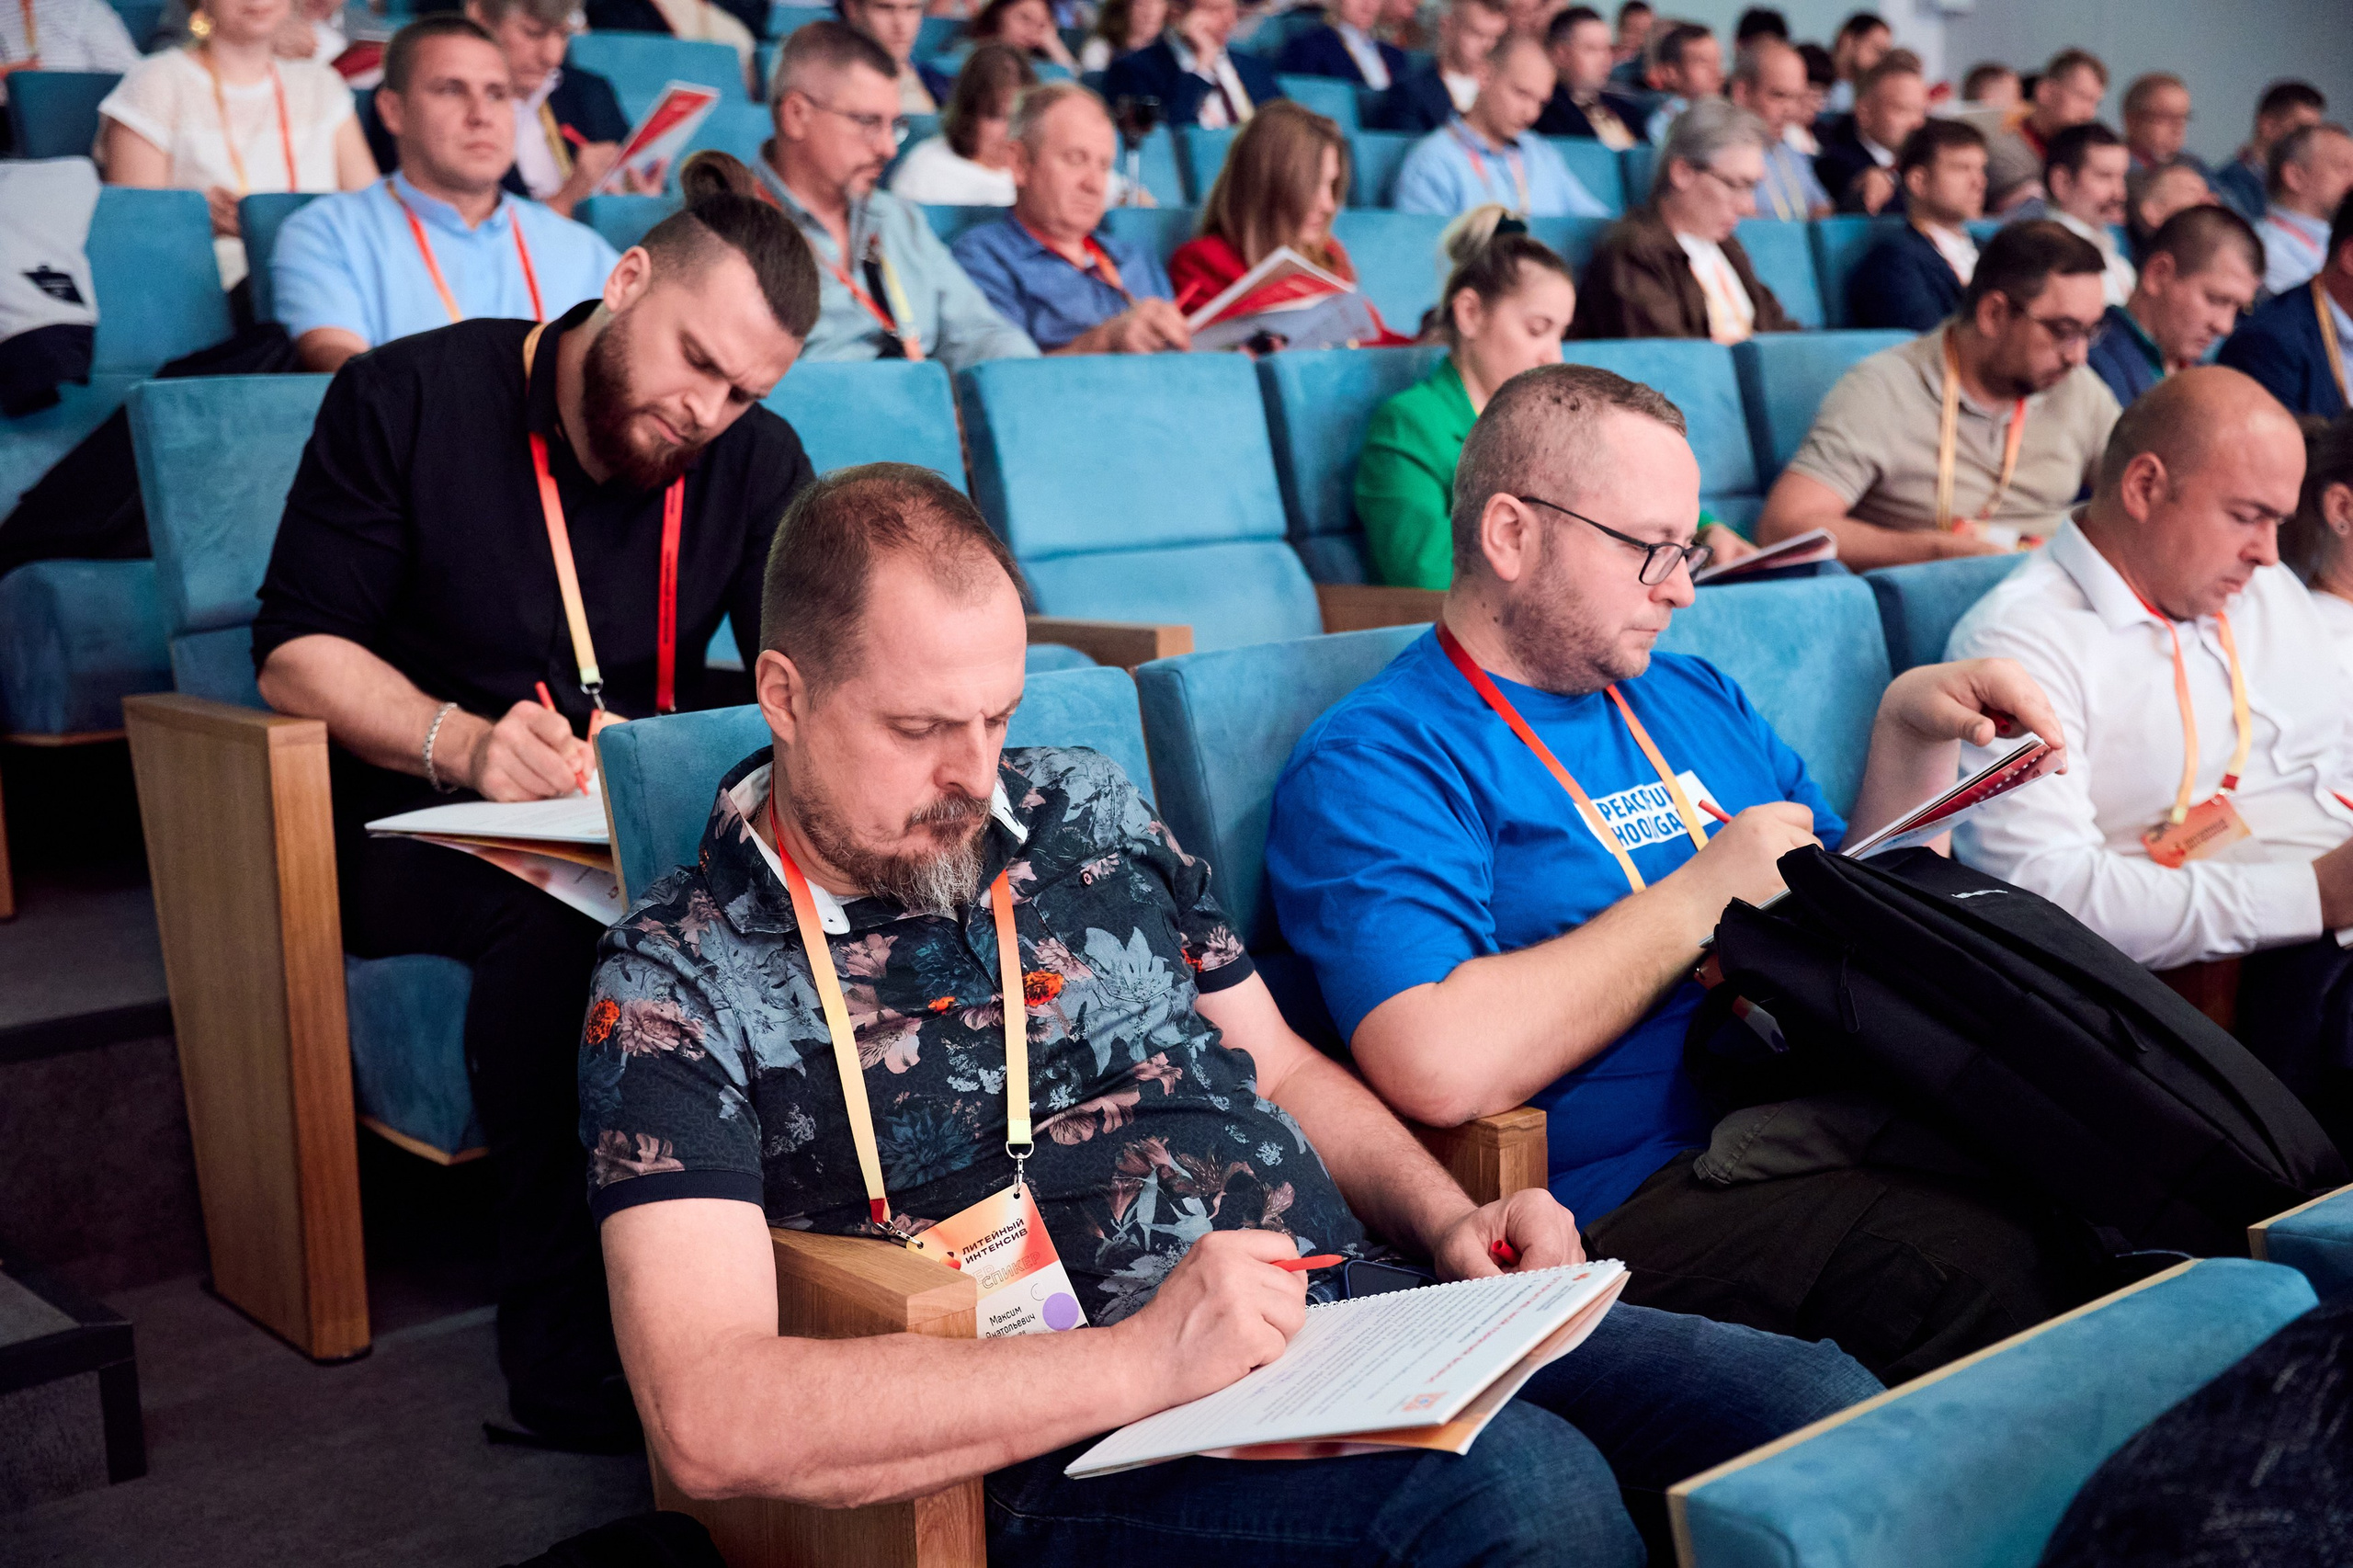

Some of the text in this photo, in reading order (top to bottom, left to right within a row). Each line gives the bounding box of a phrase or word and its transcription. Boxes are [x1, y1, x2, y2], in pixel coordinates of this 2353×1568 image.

[962, 1218, 1025, 1256] ЛИТЕЙНЫЙ
[965, 1228, 1029, 1265] ИНТЕНСИВ
[982, 1251, 1040, 1290] СПИКЕР
[985, 1313, 1036, 1339] Анатольевич
[989, 1306, 1022, 1326] Максим
